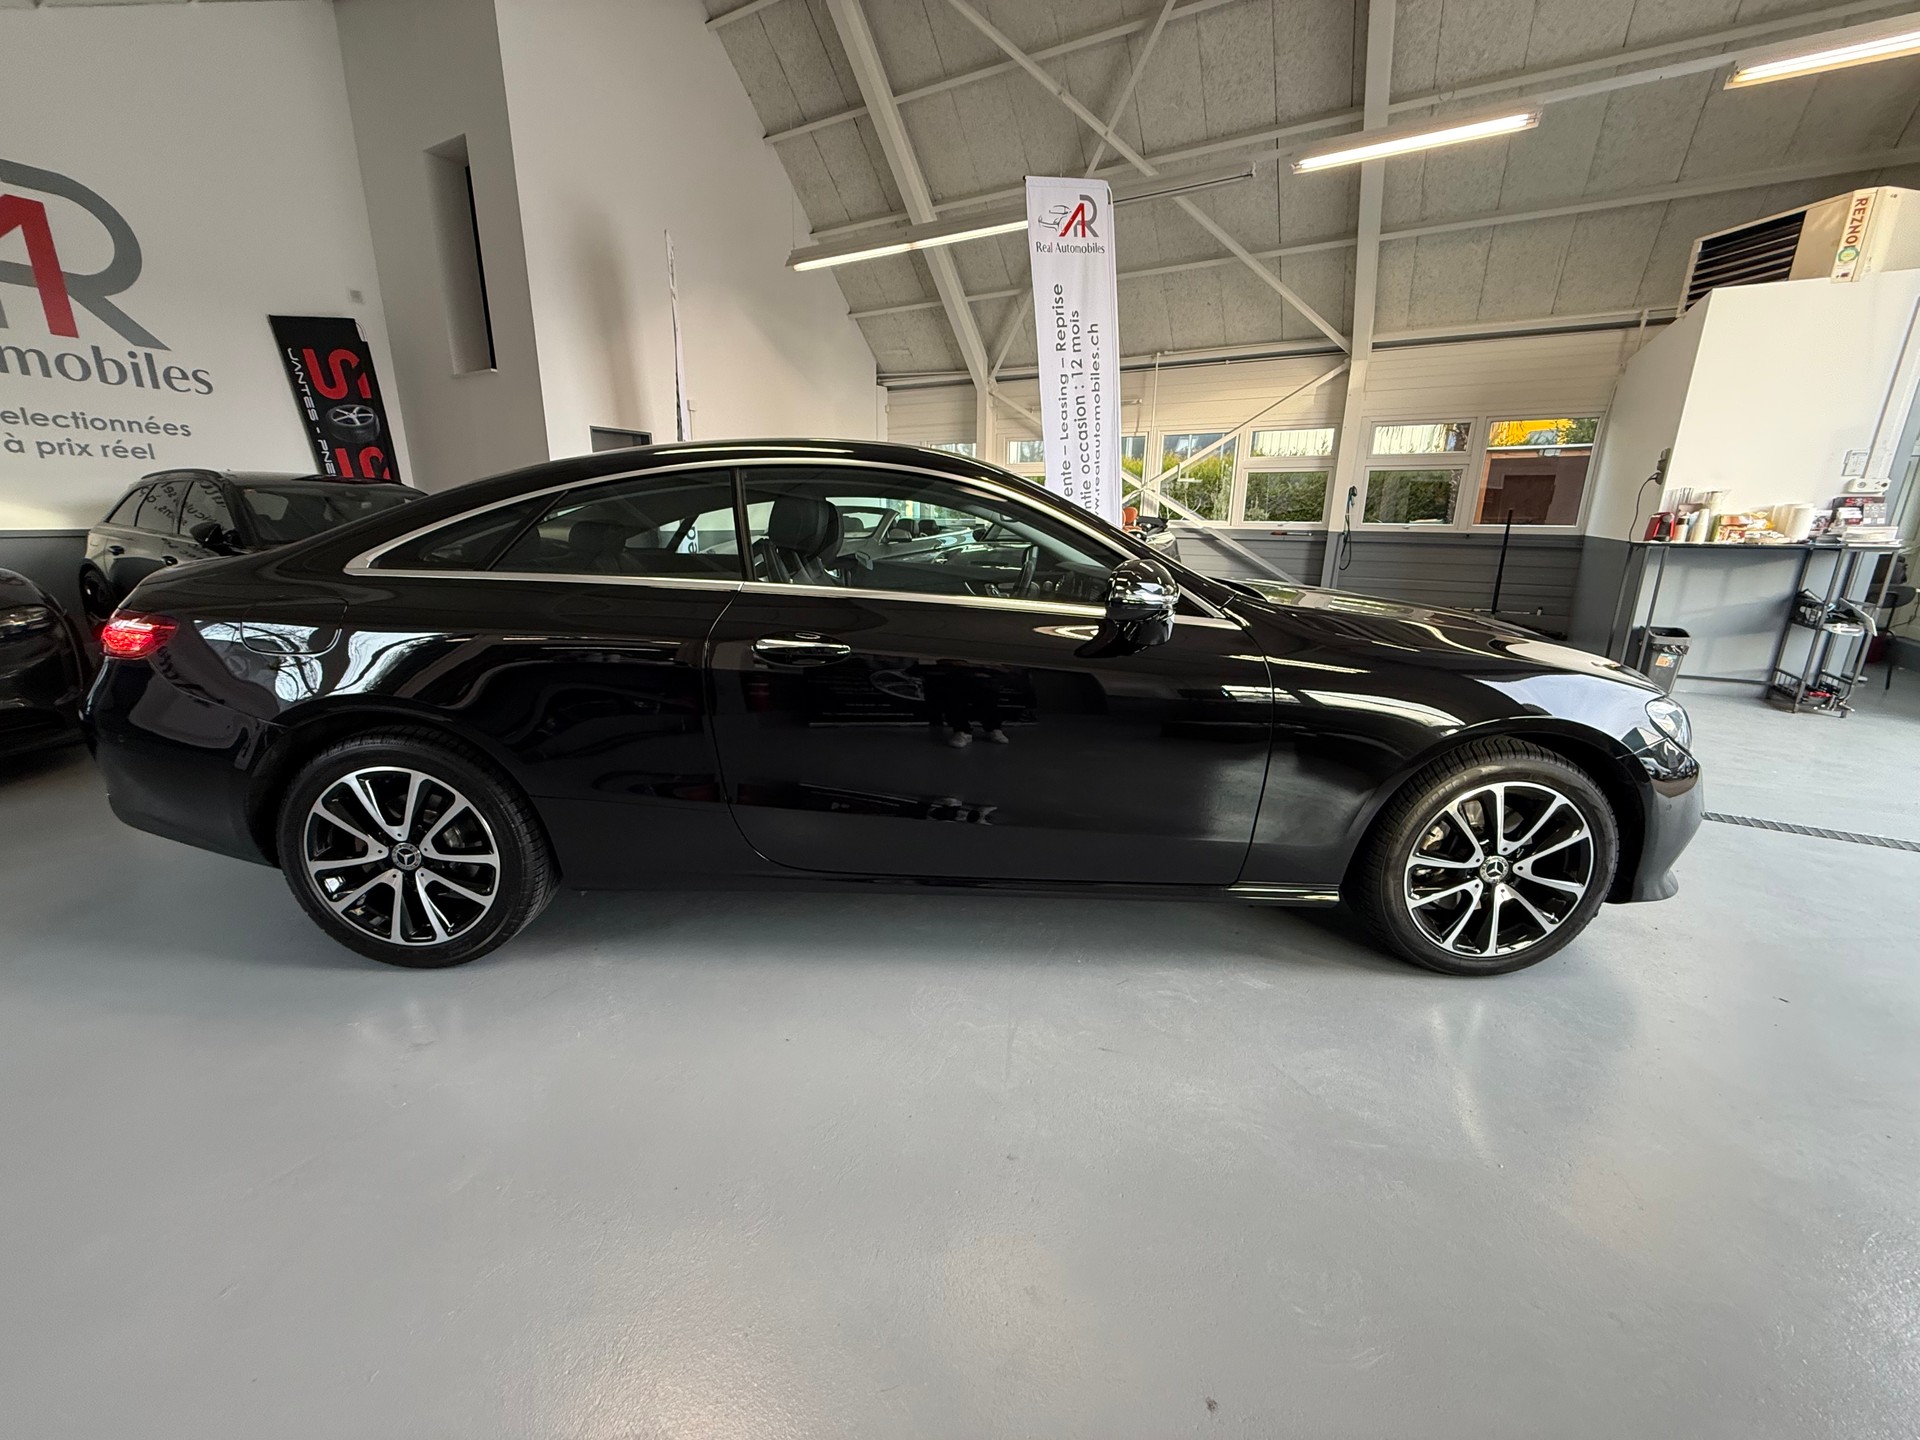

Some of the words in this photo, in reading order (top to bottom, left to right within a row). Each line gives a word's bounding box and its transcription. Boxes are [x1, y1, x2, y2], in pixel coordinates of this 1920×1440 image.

[1036, 241, 1053, 253] Real
[1055, 241, 1105, 254] Automobiles
[1052, 283, 1067, 352] Reprise
[1070, 310, 1081, 353] mois
[0, 344, 214, 395] mobiles
[1070, 358, 1083, 378] 12
[0, 406, 192, 437] electionnées
[287, 347, 319, 421] JANTES
[317, 439, 337, 477] PNE
[1058, 373, 1069, 440] Leasing
[3, 432, 25, 454] à
[35, 438, 93, 459] prix
[101, 439, 156, 460] réel
[1074, 395, 1090, 475] occasion
